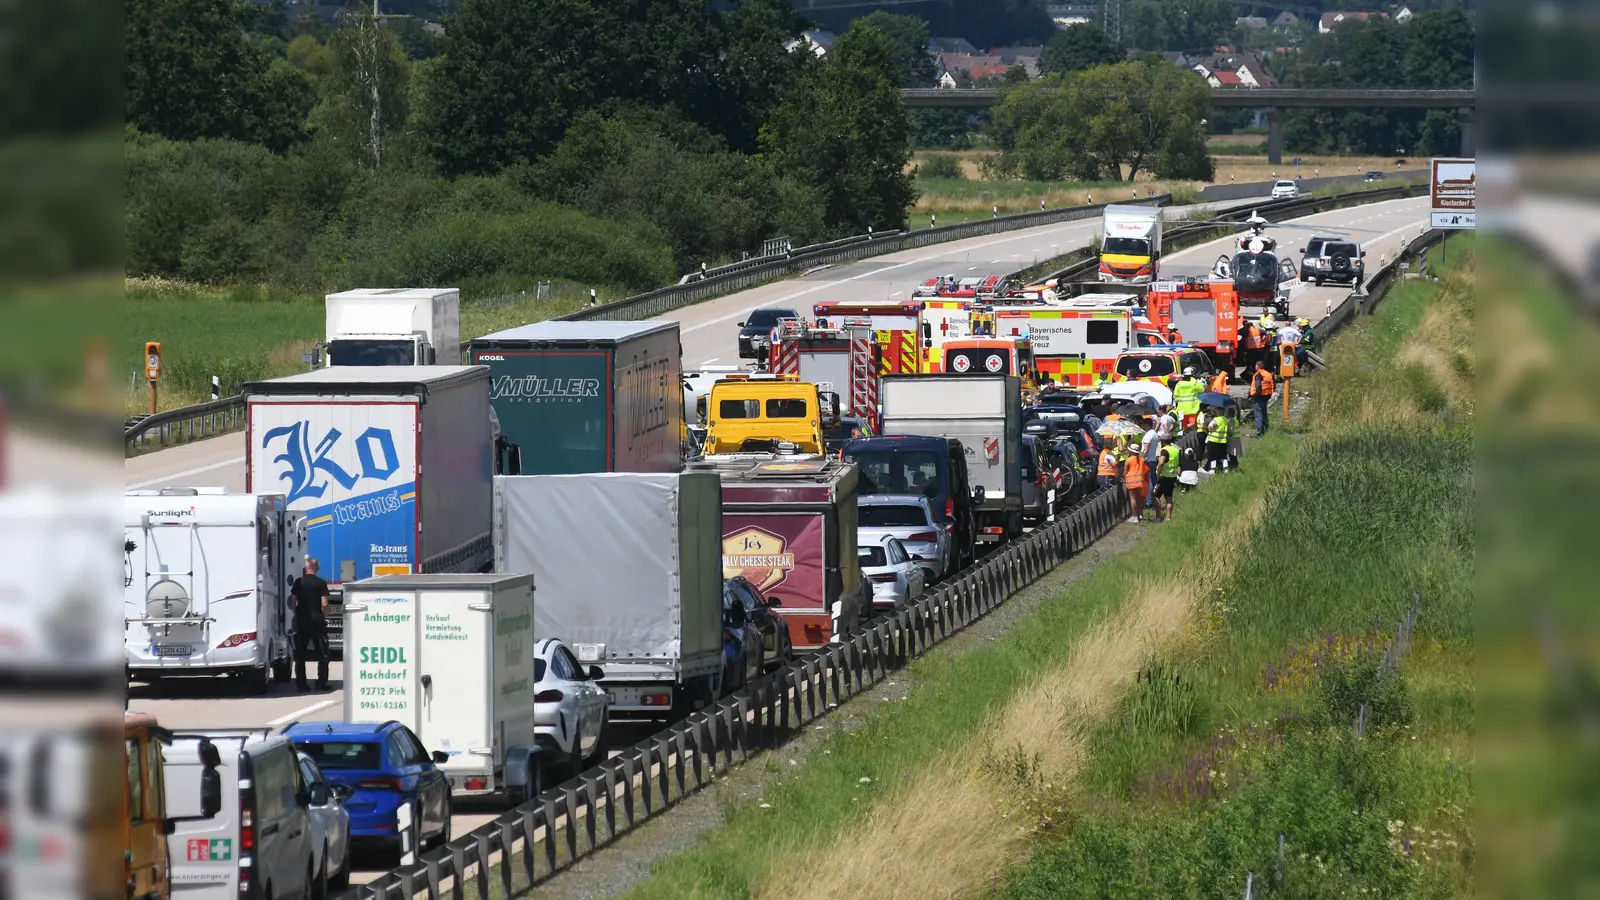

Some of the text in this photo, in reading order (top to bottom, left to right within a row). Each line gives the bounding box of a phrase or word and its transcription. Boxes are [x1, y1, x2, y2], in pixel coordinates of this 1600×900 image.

[1218, 311, 1234, 319] 112
[1030, 326, 1072, 334] Bayerisches
[262, 420, 401, 506] Ko
[334, 490, 401, 525] trans
[147, 509, 192, 518] Sunlight
[369, 543, 408, 553] Ko-trans
[740, 556, 766, 566] CHEESE
[768, 556, 790, 566] STEAK
[363, 612, 411, 624] Anhänger
[425, 624, 462, 632] Vermietung
[360, 646, 407, 664] SEIDL
[360, 669, 407, 680] Hochdorf
[360, 687, 406, 696] 92712 Pirk
